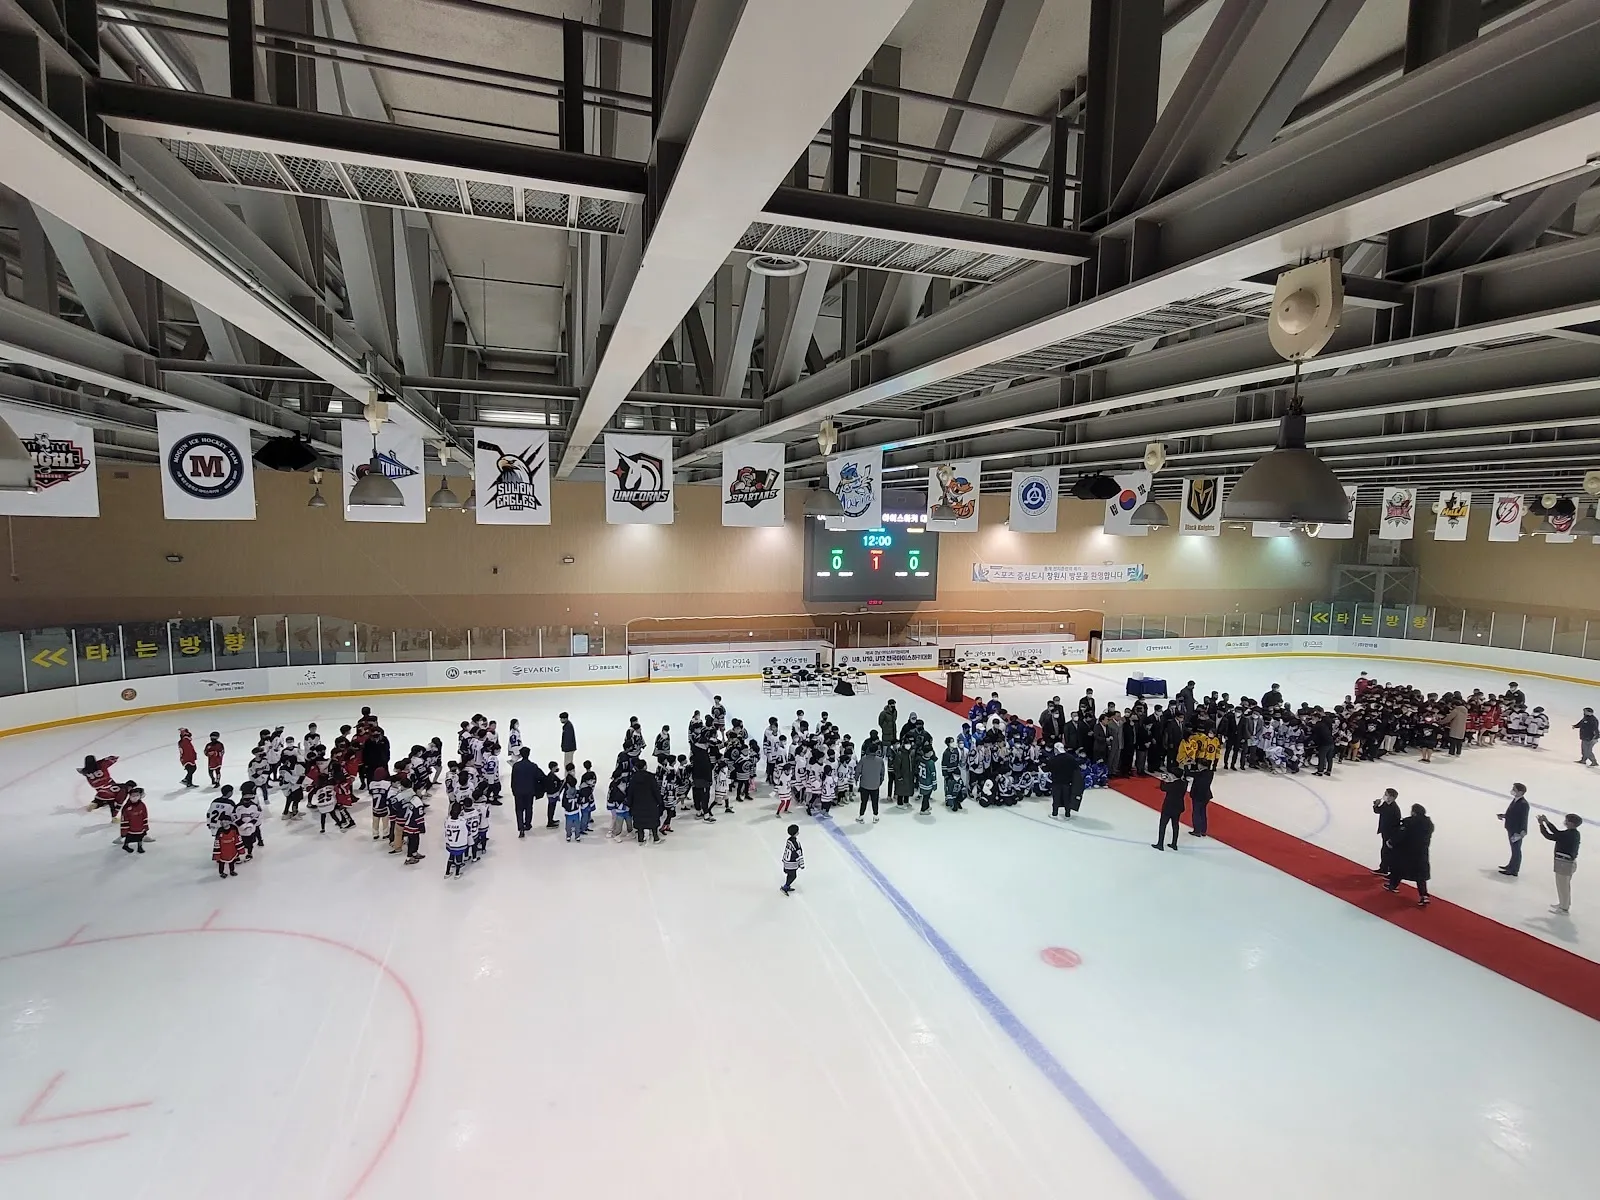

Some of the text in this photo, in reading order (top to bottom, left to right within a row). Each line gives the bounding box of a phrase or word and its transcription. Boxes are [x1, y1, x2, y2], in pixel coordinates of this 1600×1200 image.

[173, 437, 239, 465] MOGUN ICE HOCKEY TEAM
[189, 455, 225, 478] M
[497, 482, 534, 496] SUWON
[614, 490, 669, 502] UNICORNS
[496, 494, 536, 509] EAGLES
[731, 490, 777, 503] SPARTANS
[862, 535, 892, 546] 12:00
[832, 556, 842, 570] 0
[872, 556, 879, 570] 1
[909, 556, 919, 570] 0
[1017, 572, 1045, 580] 중심도시
[1046, 572, 1067, 580] 창원시
[1069, 572, 1089, 580] 방문을
[1090, 571, 1123, 580] 환영합니다
[523, 666, 561, 674] EVAKING
[317, 790, 333, 803] 25
[446, 829, 461, 843] 27
